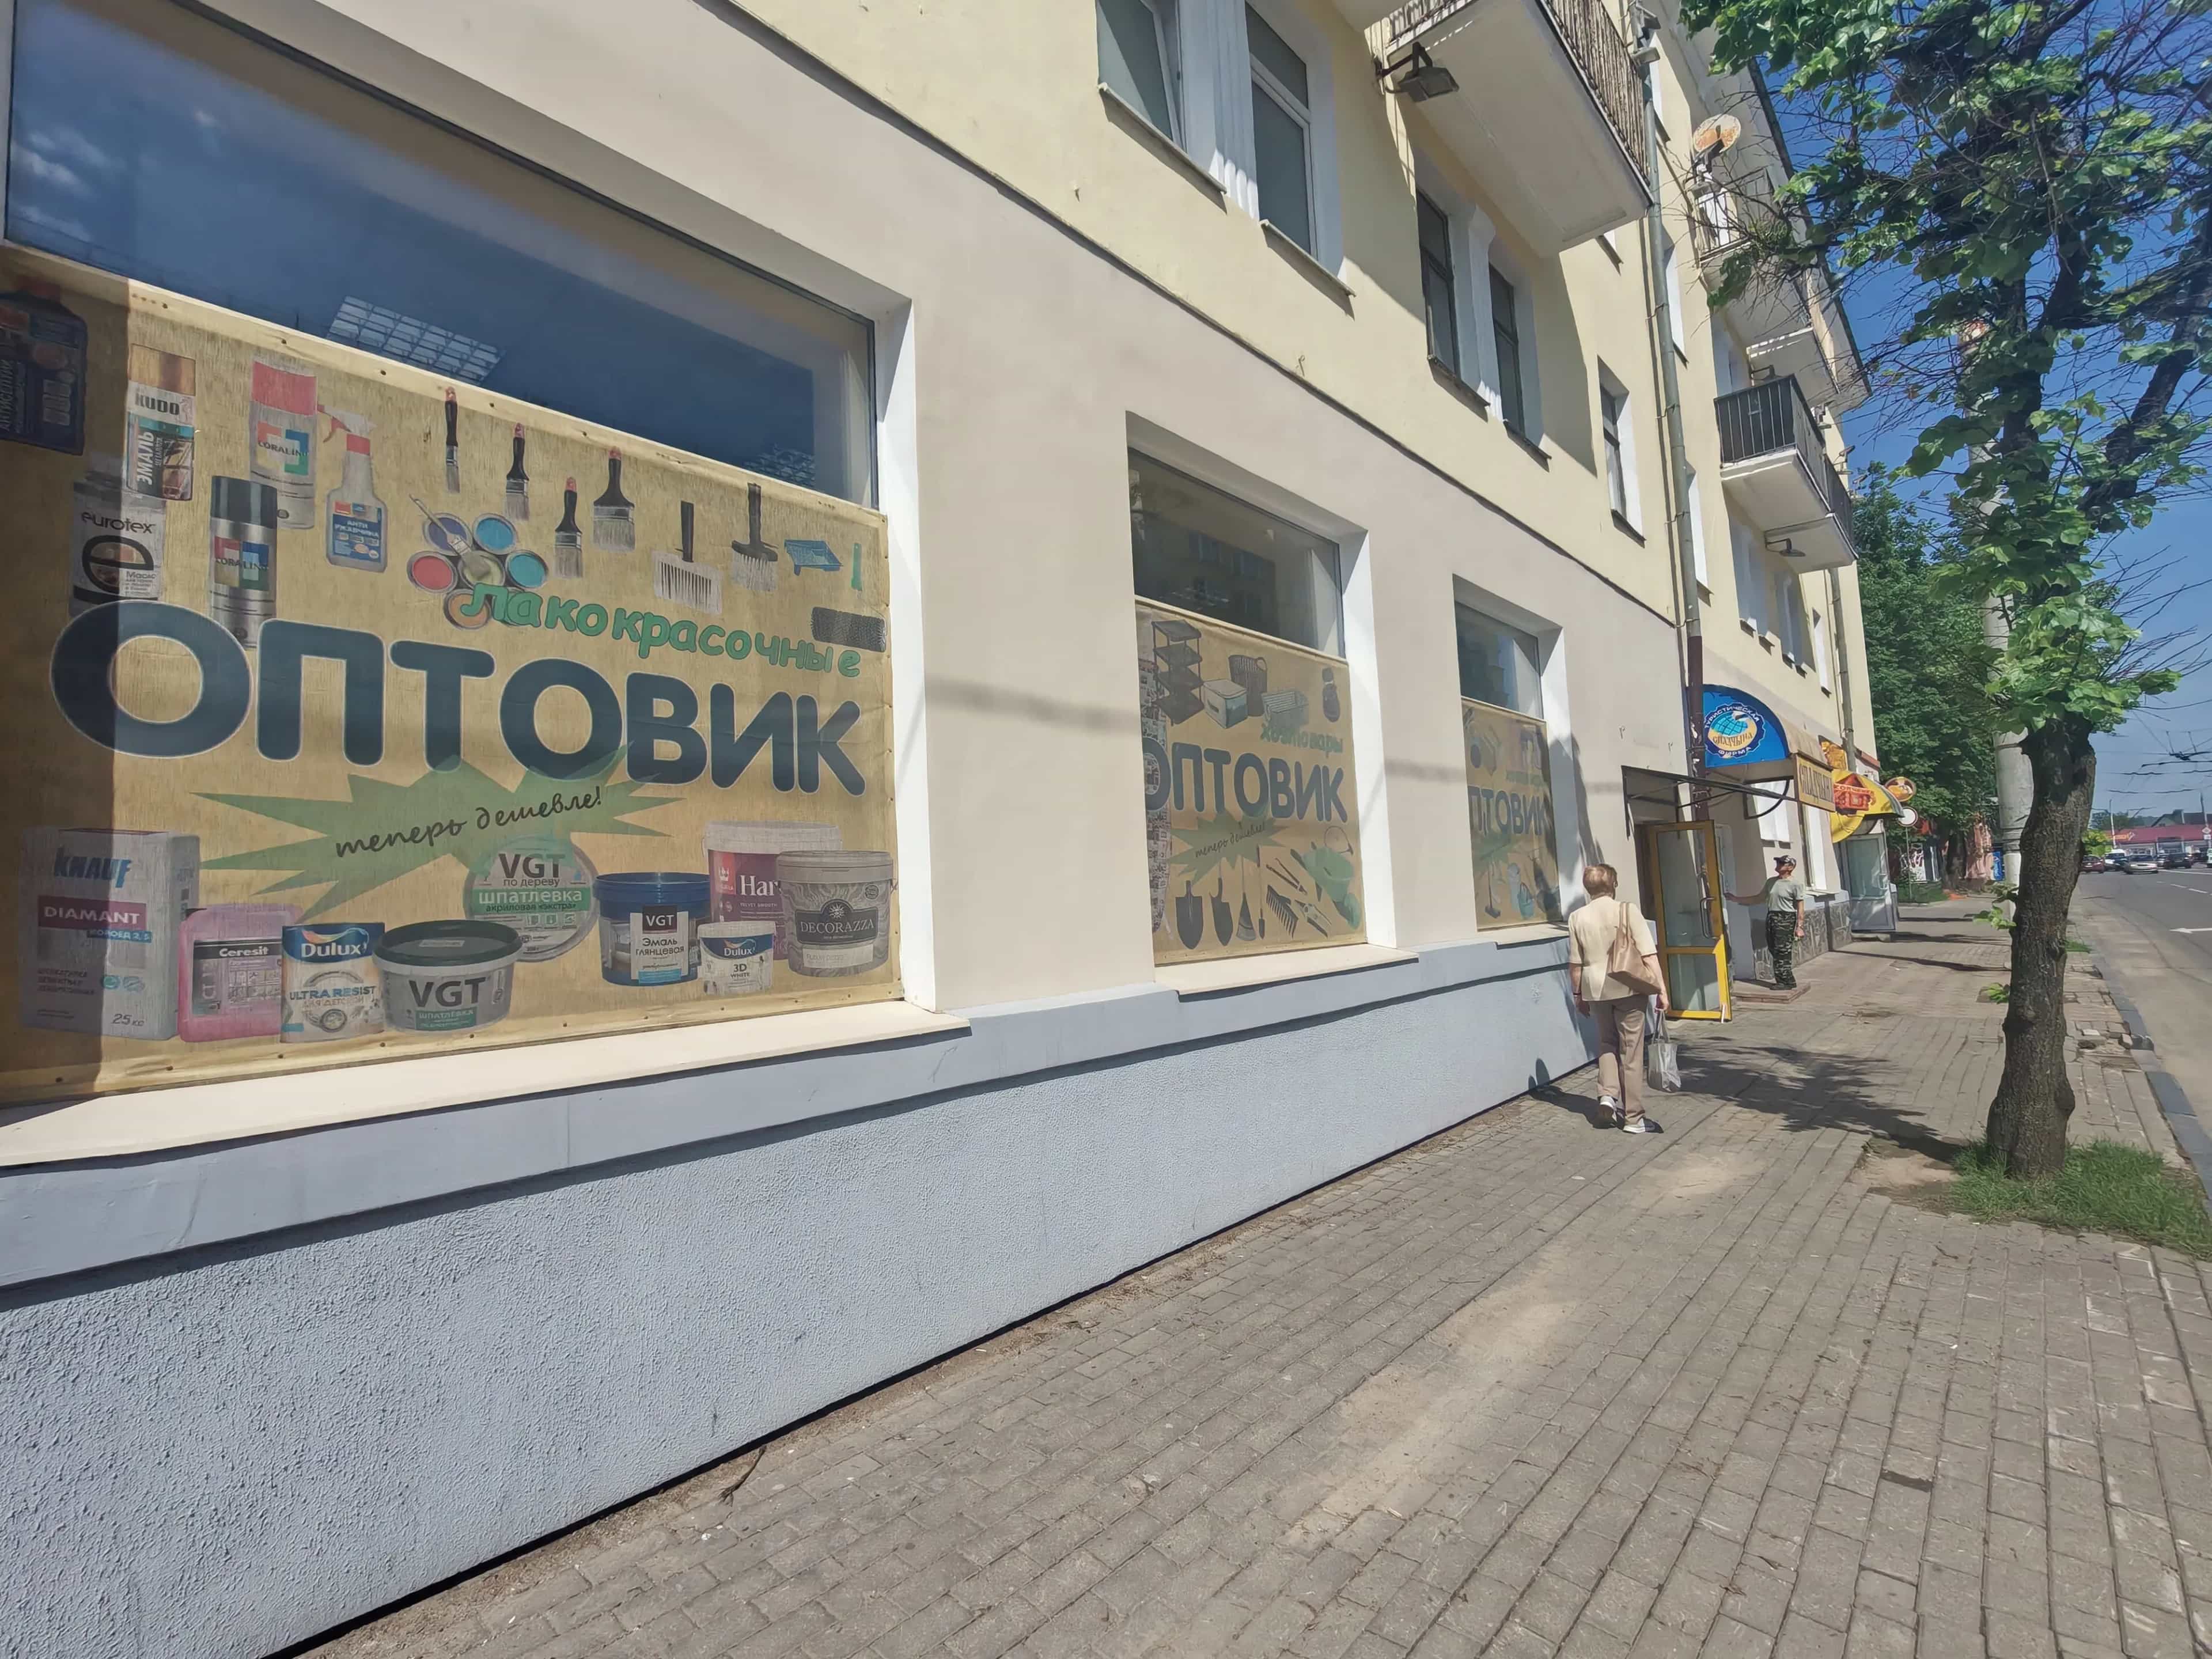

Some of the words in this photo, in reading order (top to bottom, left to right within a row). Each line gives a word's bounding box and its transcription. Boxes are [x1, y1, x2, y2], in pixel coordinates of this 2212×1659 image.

[137, 431, 154, 486] ЭМАЛЬ
[81, 511, 156, 534] eurotex
[50, 600, 867, 797] ОПТОВИК
[336, 817, 468, 858] теперь
[475, 786, 603, 830] дешевле!
[498, 853, 566, 878] VGT
[479, 890, 582, 904] шпатлевка
[43, 906, 141, 925] DIAMANT
[646, 915, 674, 927] VGT
[801, 919, 874, 934] DECORAZZA
[642, 937, 677, 946] Эмаль
[219, 946, 269, 957] Ceresit
[300, 942, 361, 958] Dulux
[724, 948, 753, 957] Dulux
[733, 963, 747, 972] 3D
[290, 987, 328, 1000] ULTRA
[332, 986, 376, 997] RESIST
[408, 977, 486, 1007] VGT
[111, 1013, 132, 1025] 25
